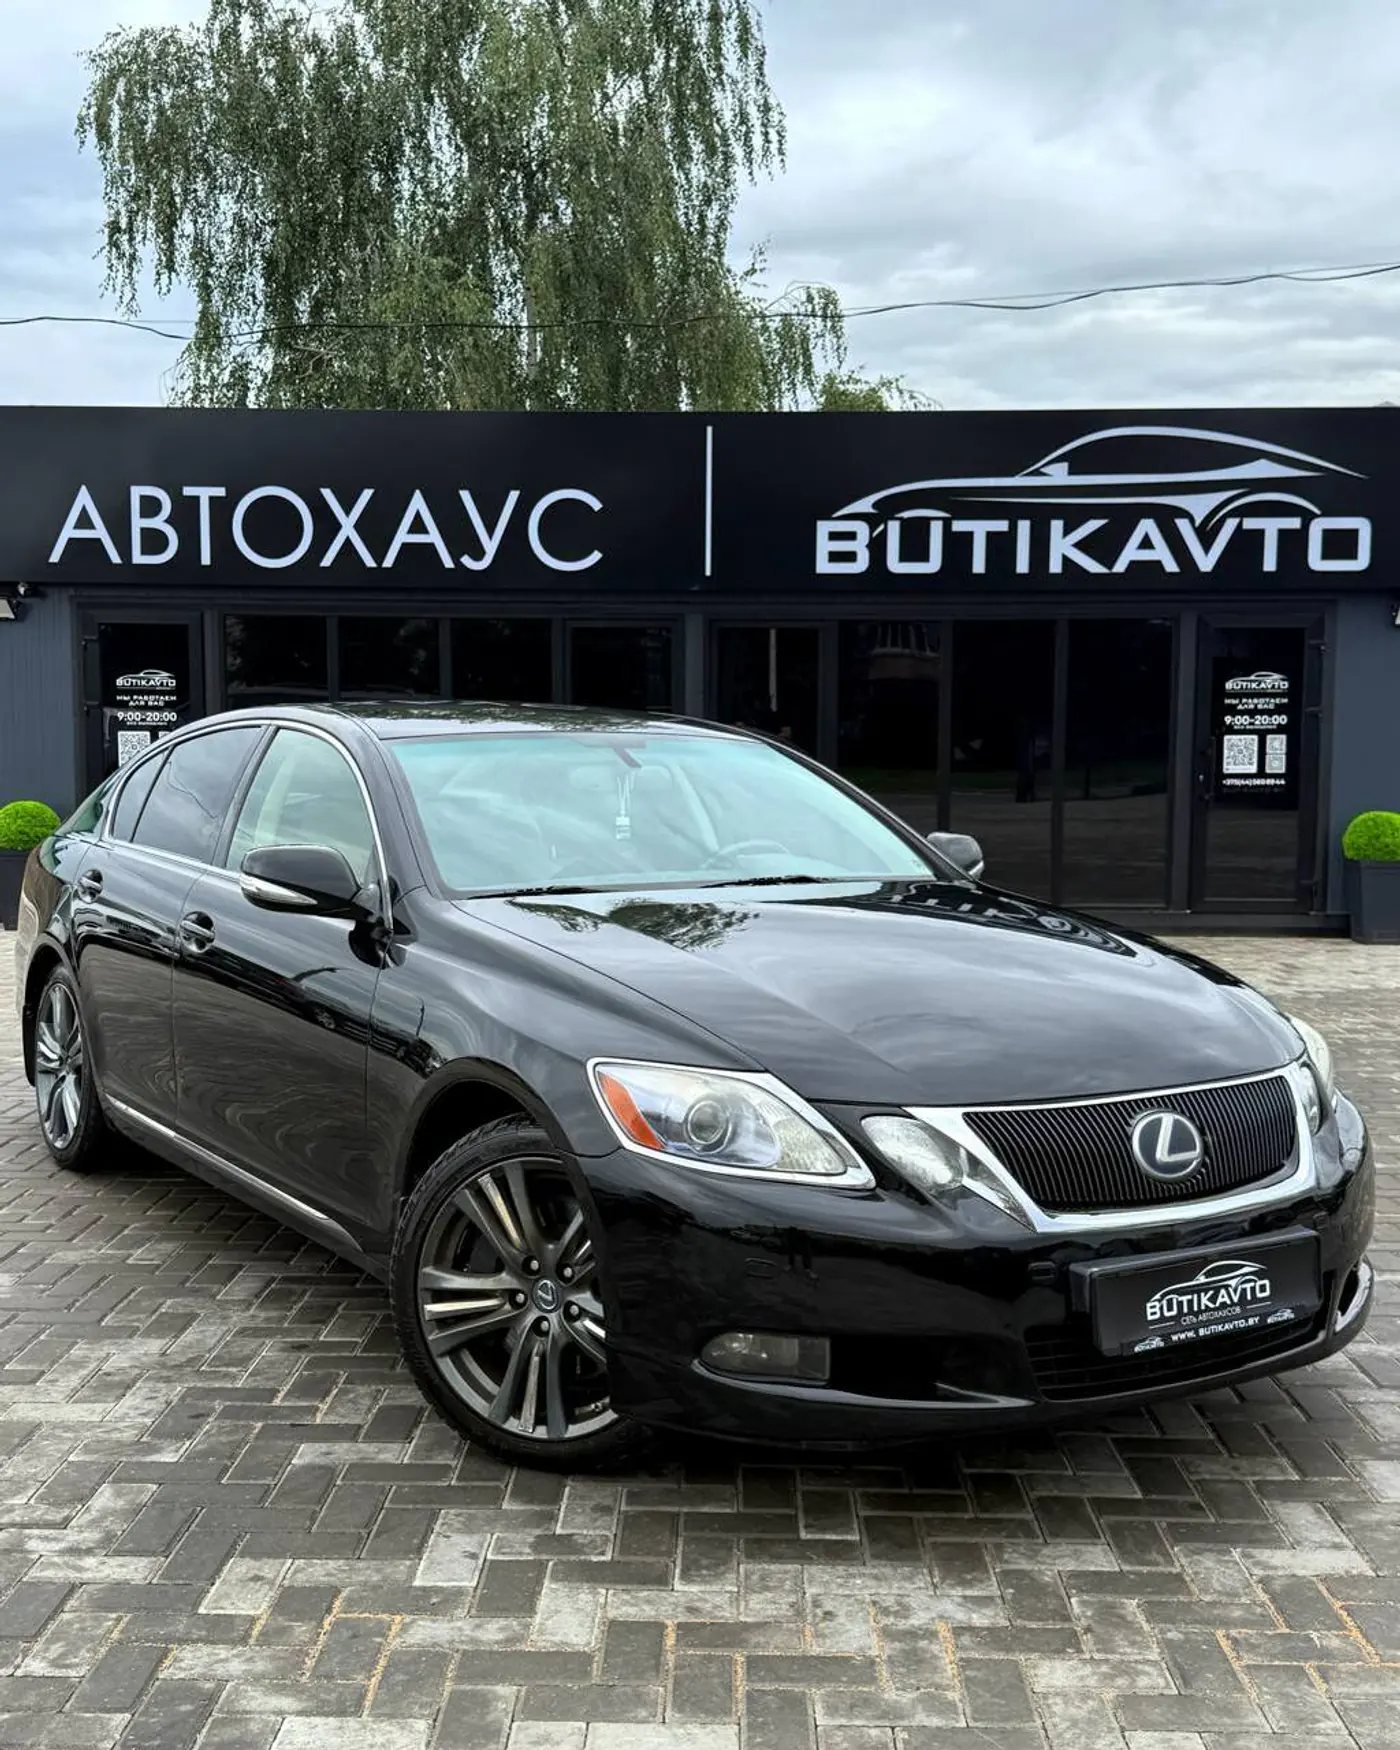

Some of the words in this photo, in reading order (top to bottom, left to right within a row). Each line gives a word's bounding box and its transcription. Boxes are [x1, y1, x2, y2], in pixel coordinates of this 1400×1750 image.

[48, 484, 603, 572] АВТОХАУС
[815, 516, 1373, 575] BUTIKAVTO
[1225, 681, 1288, 689] BUTIKAVTO
[117, 712, 177, 721] 9:00-20:00
[1224, 715, 1287, 724] 9:00-20:00
[1146, 1279, 1270, 1321] BUTIKAVTO
[1181, 1315, 1197, 1325] СЕТЬ
[1198, 1316, 1260, 1337] BUTIKAVTO.BY
